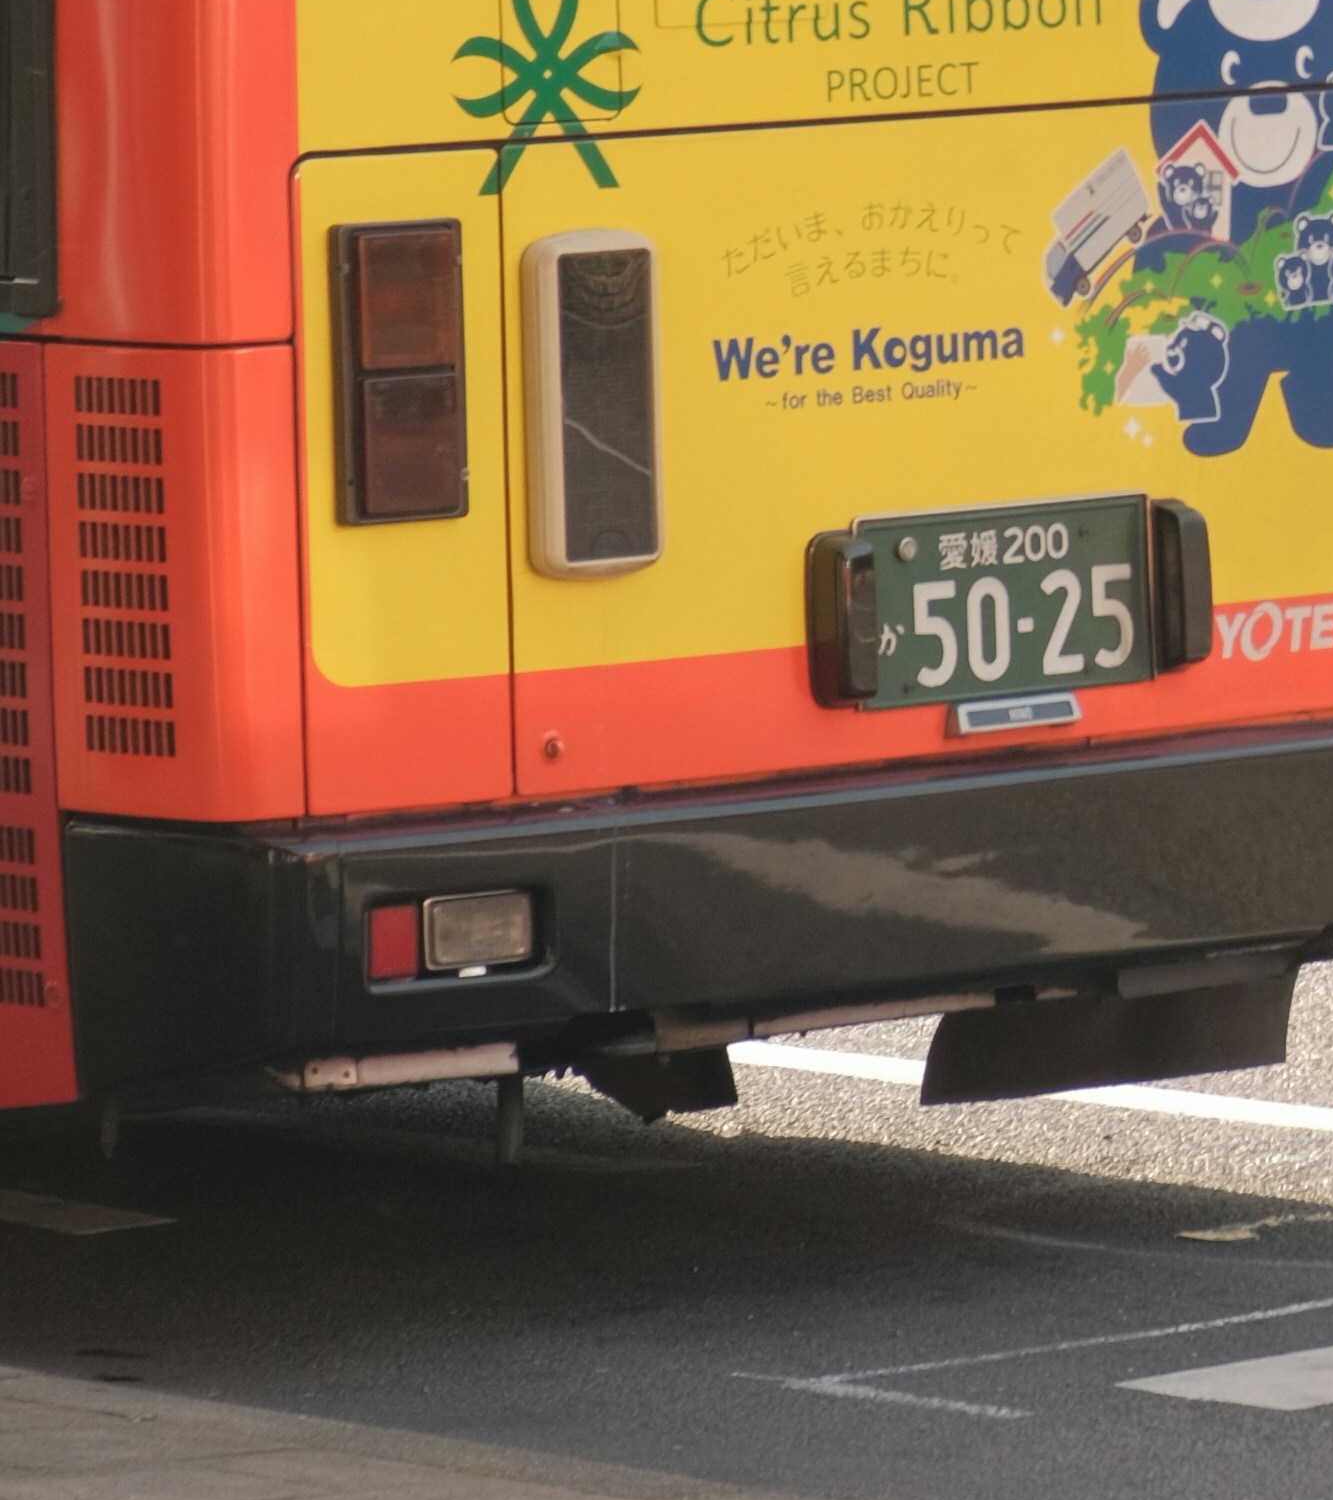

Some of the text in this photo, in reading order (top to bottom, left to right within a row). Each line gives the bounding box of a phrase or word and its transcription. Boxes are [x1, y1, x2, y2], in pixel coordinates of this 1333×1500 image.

[826, 61, 979, 102] PROJECT
[852, 326, 1025, 374] Koguma
[816, 388, 843, 406] the
[852, 384, 891, 405] Best
[912, 562, 1135, 688] 50-25
